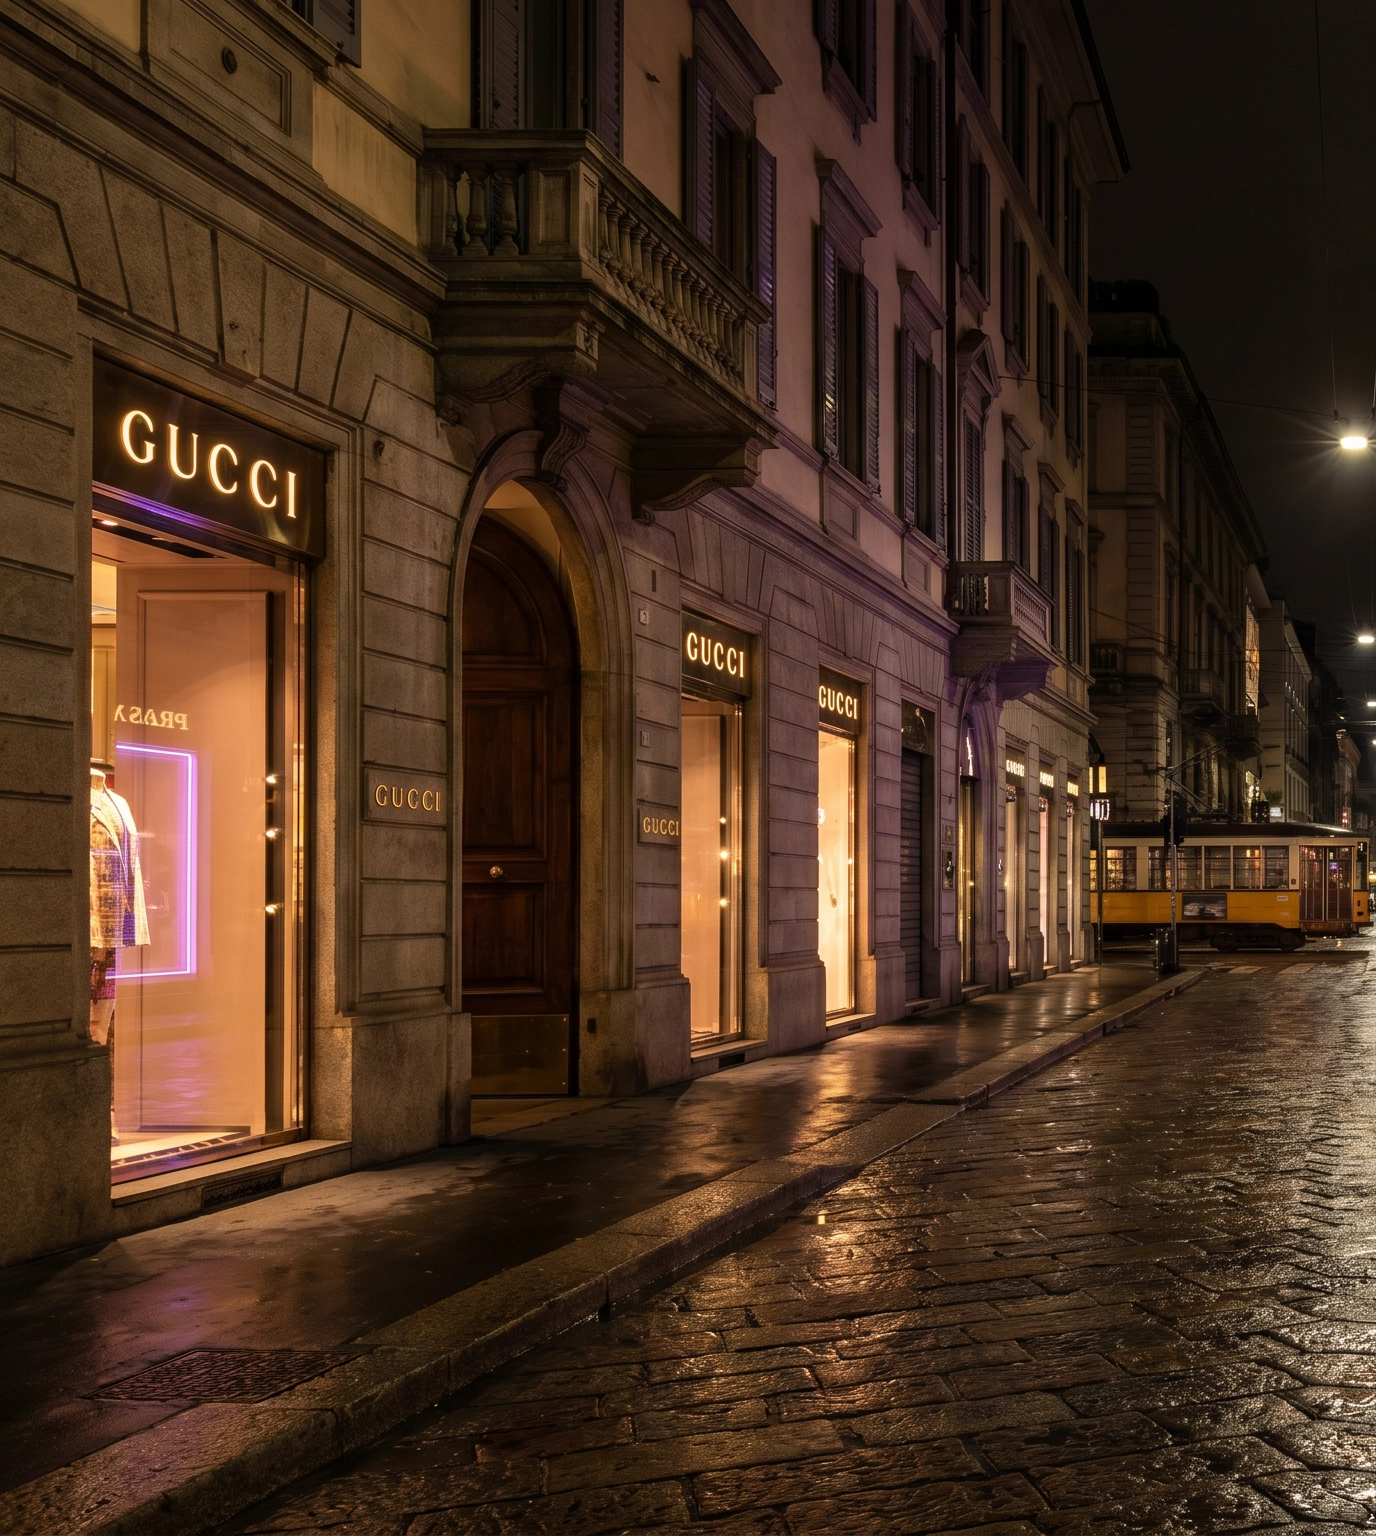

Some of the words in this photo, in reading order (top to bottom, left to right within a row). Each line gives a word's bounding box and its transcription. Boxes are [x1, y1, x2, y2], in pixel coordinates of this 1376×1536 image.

[120, 409, 297, 519] GUCCI
[686, 632, 745, 678] GUCCI
[818, 685, 858, 720] GUCCI
[375, 784, 441, 812] GUCCI
[643, 816, 680, 836] GUCCI
